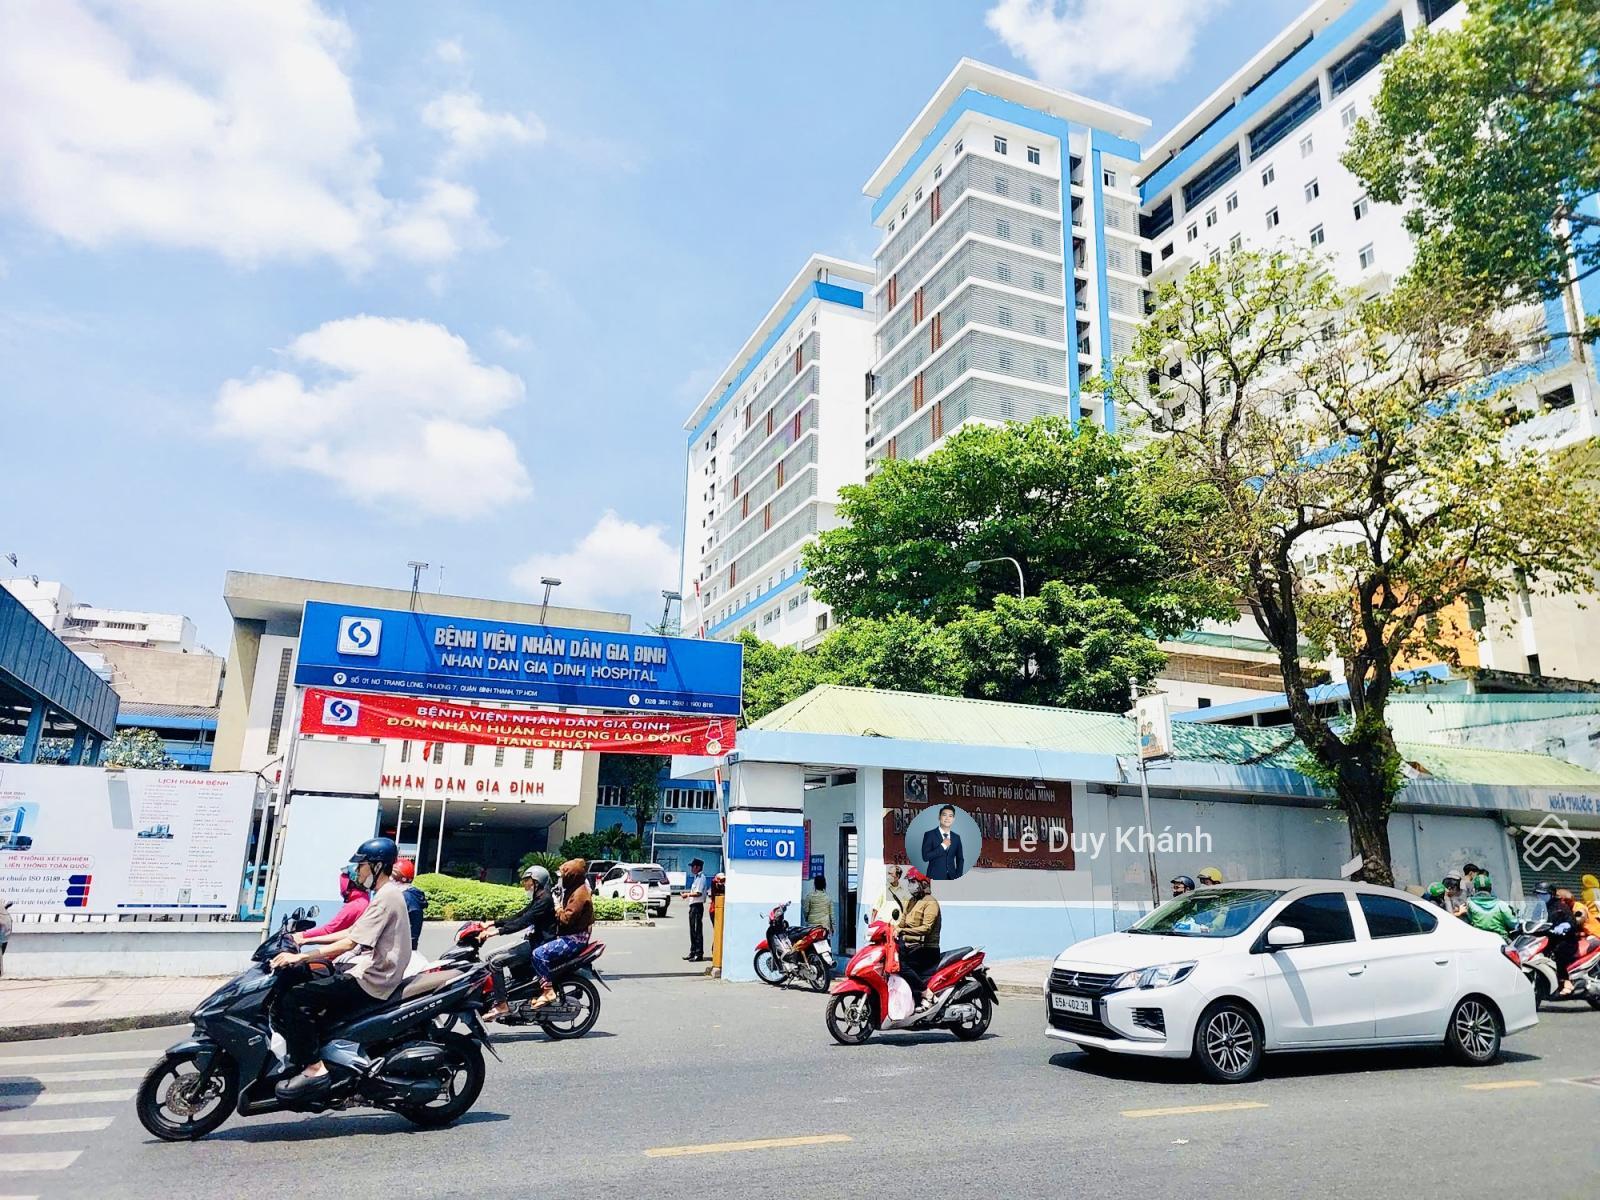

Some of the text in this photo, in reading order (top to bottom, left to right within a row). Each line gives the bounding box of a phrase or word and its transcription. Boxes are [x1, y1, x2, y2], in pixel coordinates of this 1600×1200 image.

[434, 625, 667, 667] BỆNH VIỆN NHÂN DÂN GIA ĐỊNH
[441, 654, 658, 682] NHAN DAN GIA DINH HOSPITAL
[384, 679, 405, 688] TRANG
[417, 706, 670, 731] BỆNH VIỆN NHÂN DÂN GIA ĐỊNH
[387, 717, 692, 744] ĐÓN NHẬN HUÂN CHƯƠNG LAO ĐỘNG
[496, 737, 593, 750] HẠNG NHẤT
[180, 777, 204, 785] KHÁM
[381, 774, 544, 795] NHÂN DÂN GIA ĐỊNH
[955, 784, 961, 796] Y
[962, 780, 971, 797] TẾ
[972, 782, 996, 799] THÀNH
[998, 783, 1013, 800] PHỐ
[1014, 784, 1024, 801] HỒ
[1024, 786, 1037, 802] CHÍ
[1038, 789, 1056, 803] MINH
[748, 849, 767, 857] GATE
[775, 840, 795, 857] 01
